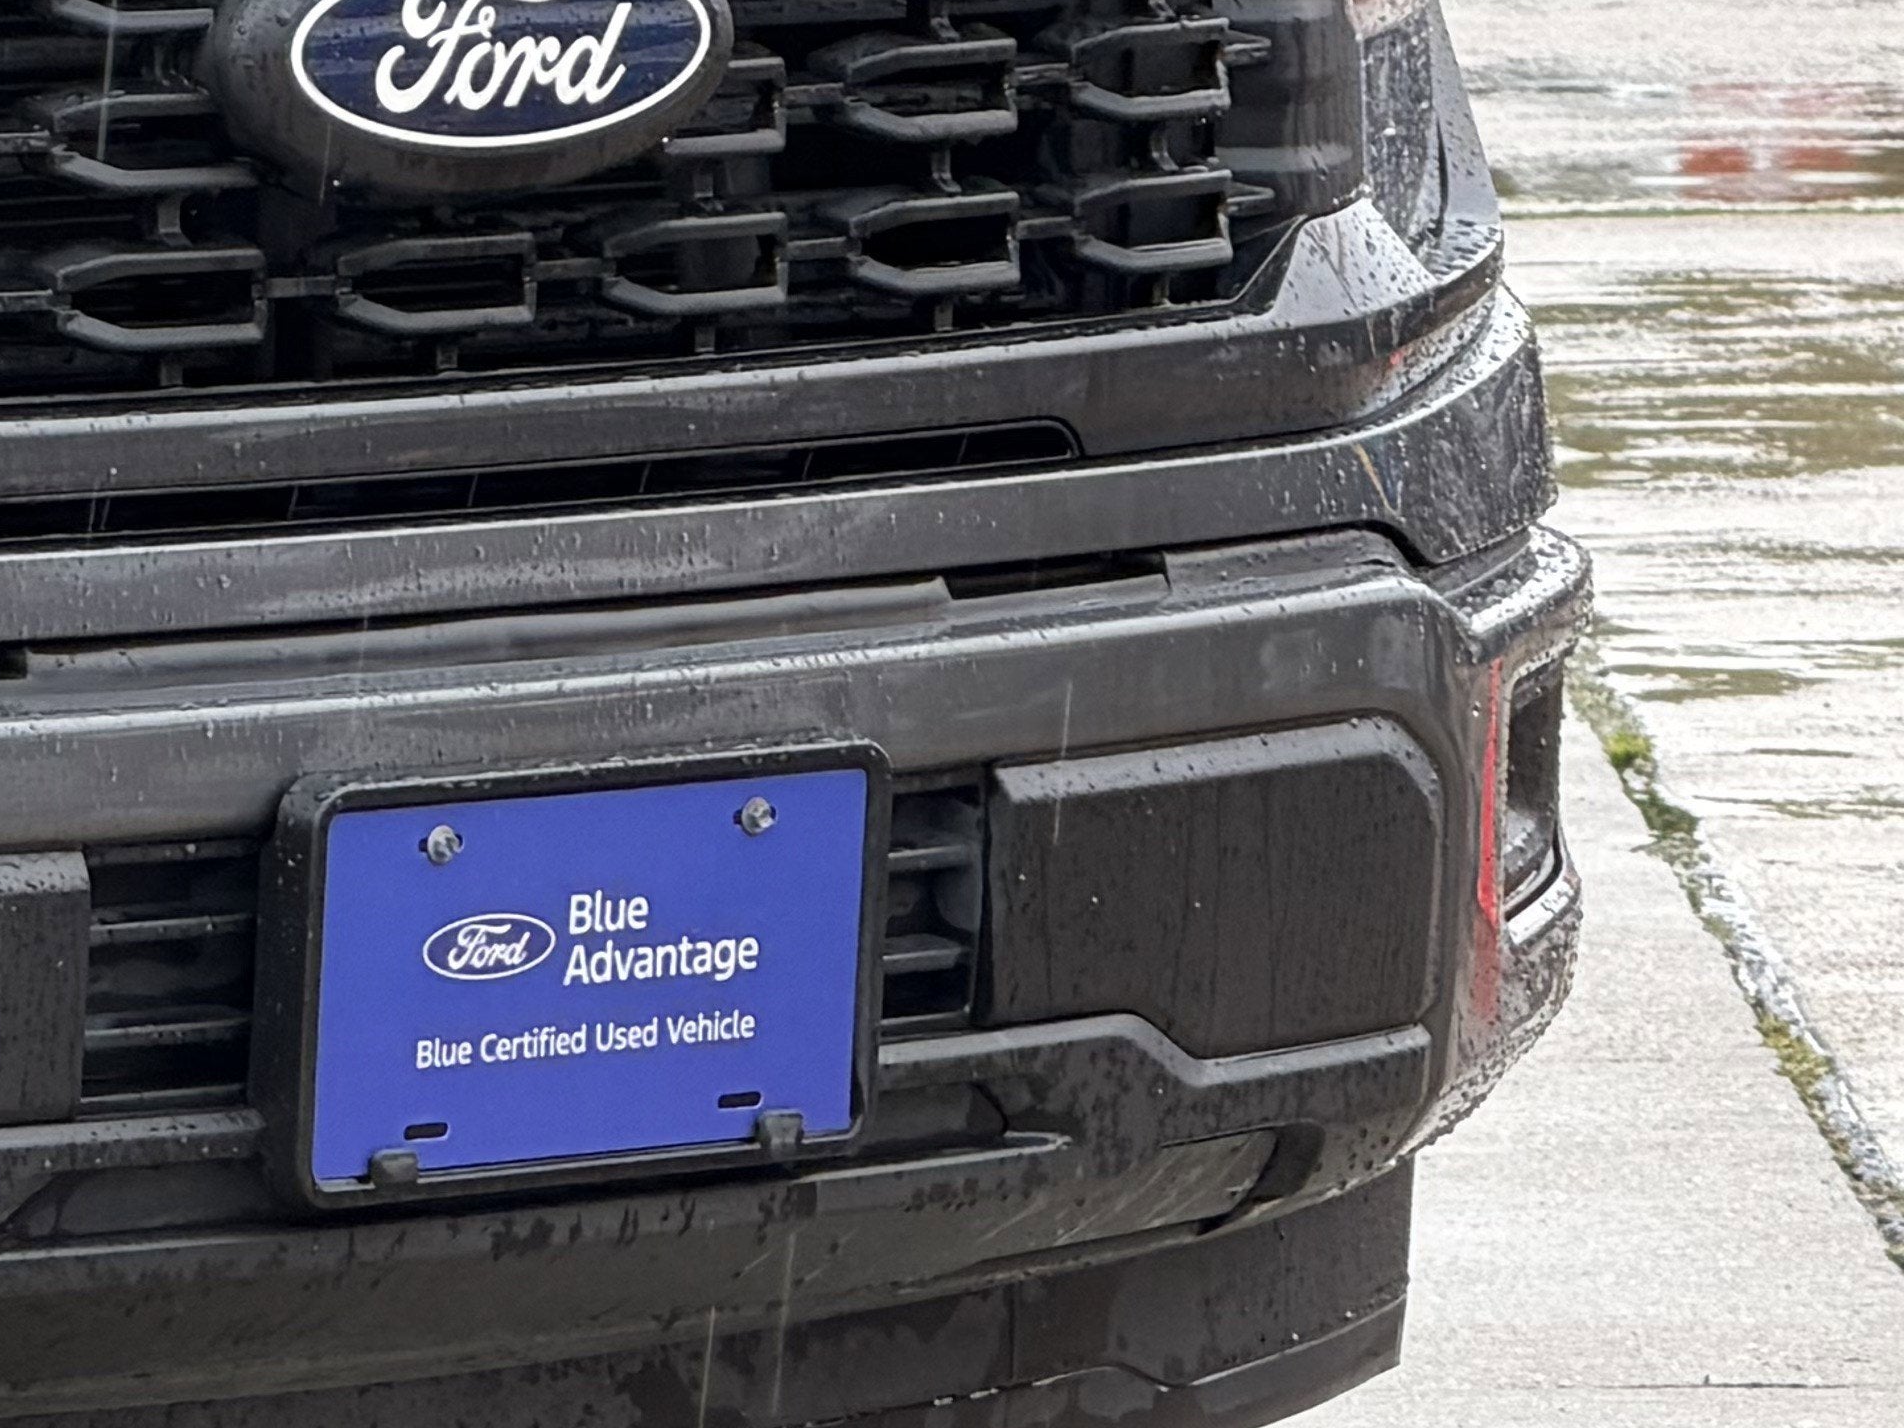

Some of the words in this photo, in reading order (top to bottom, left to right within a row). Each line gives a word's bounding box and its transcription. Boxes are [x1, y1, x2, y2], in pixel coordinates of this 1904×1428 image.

[568, 890, 649, 935] Blue
[448, 923, 531, 970] Ford
[562, 935, 759, 987] Advantage
[415, 1037, 473, 1070] Blue
[479, 1022, 588, 1063] Certified
[594, 1016, 659, 1052] Used
[666, 1008, 756, 1045] Vehicle
